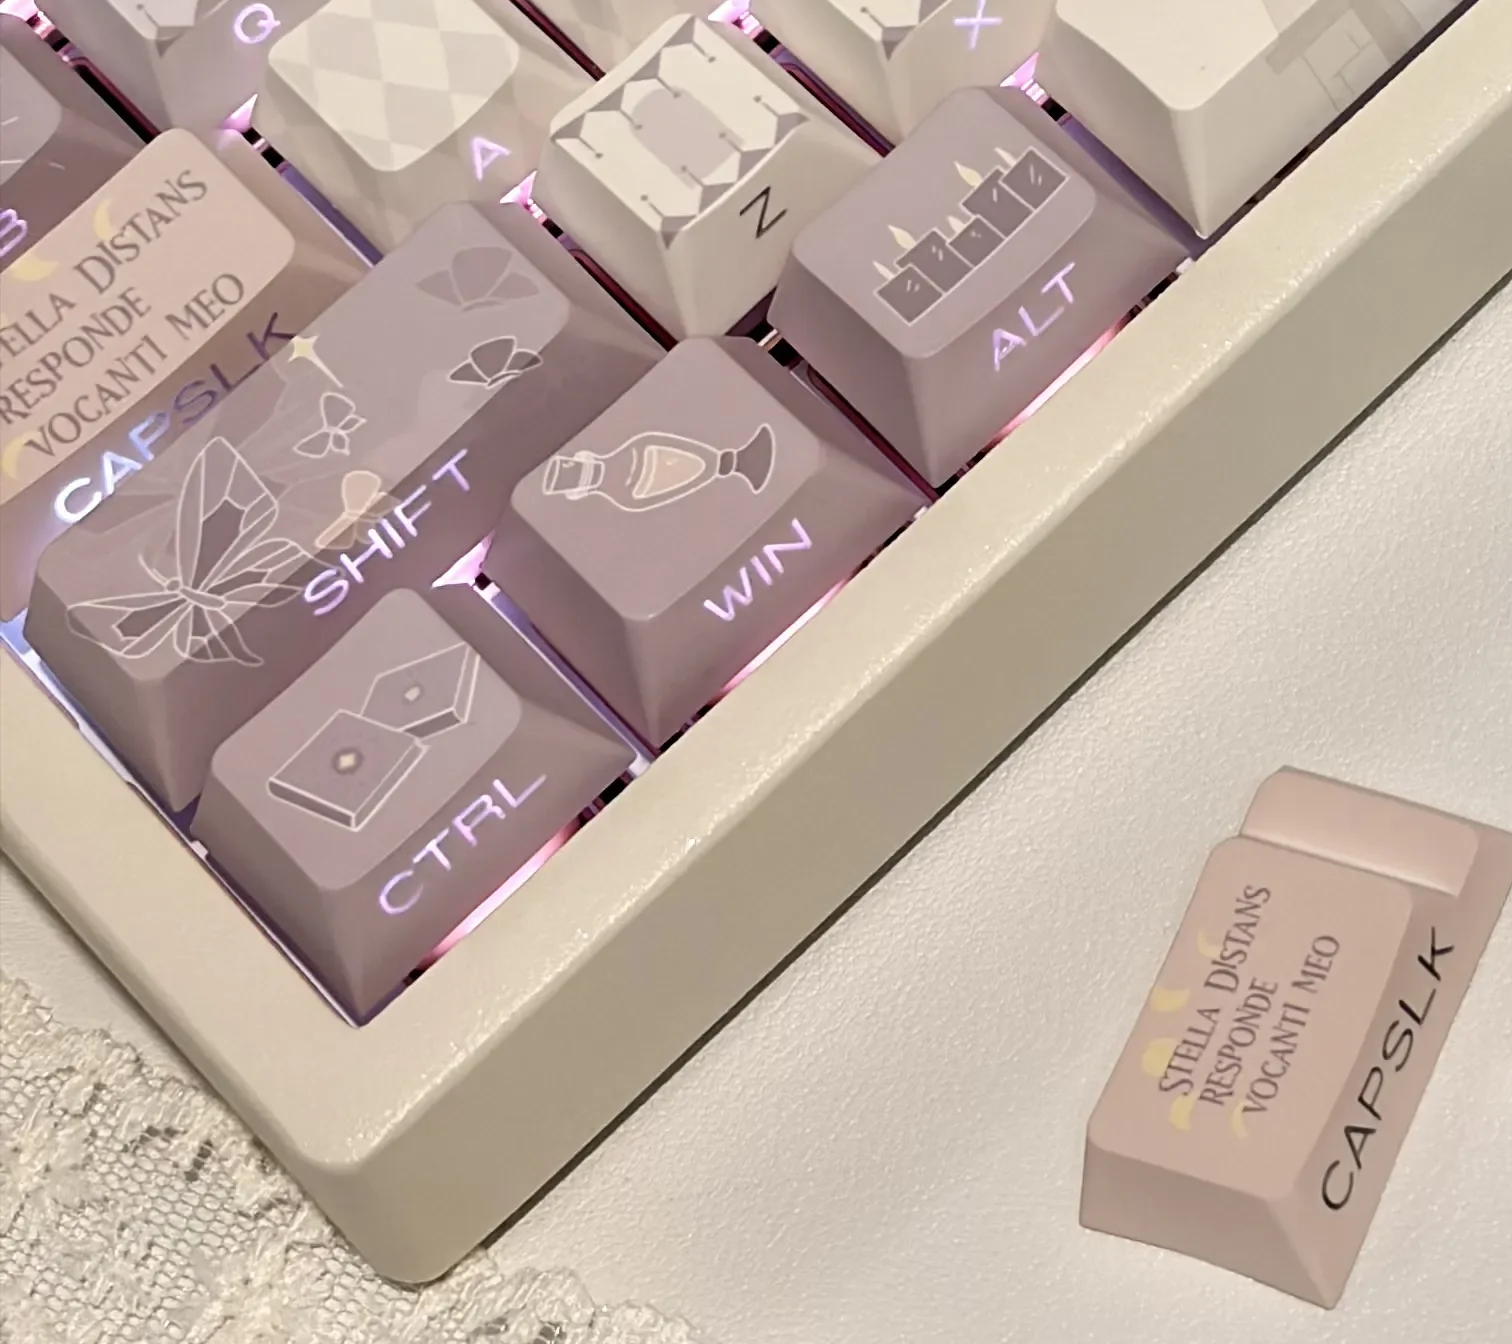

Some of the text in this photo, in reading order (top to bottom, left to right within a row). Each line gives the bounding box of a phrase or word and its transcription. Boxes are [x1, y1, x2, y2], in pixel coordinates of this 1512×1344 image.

[232, 2, 281, 45] Q
[471, 136, 511, 181] A
[739, 186, 788, 239] Z
[0, 293, 77, 358] ELLA
[73, 170, 208, 294] DISTANS
[992, 262, 1075, 372] ALT
[0, 287, 152, 424] RESPONDE
[24, 273, 246, 456] VOCANTI MEO
[53, 312, 297, 524] CAPSLK
[303, 448, 472, 617] SHIFT
[704, 517, 812, 622] WIN
[377, 774, 547, 916] CTRL
[1159, 884, 1272, 1097] STELLA DISTANS
[1199, 977, 1279, 1107] RESPONDE
[1242, 934, 1341, 1117] VOCANTI MEO
[1321, 926, 1455, 1211] CAPSLK
